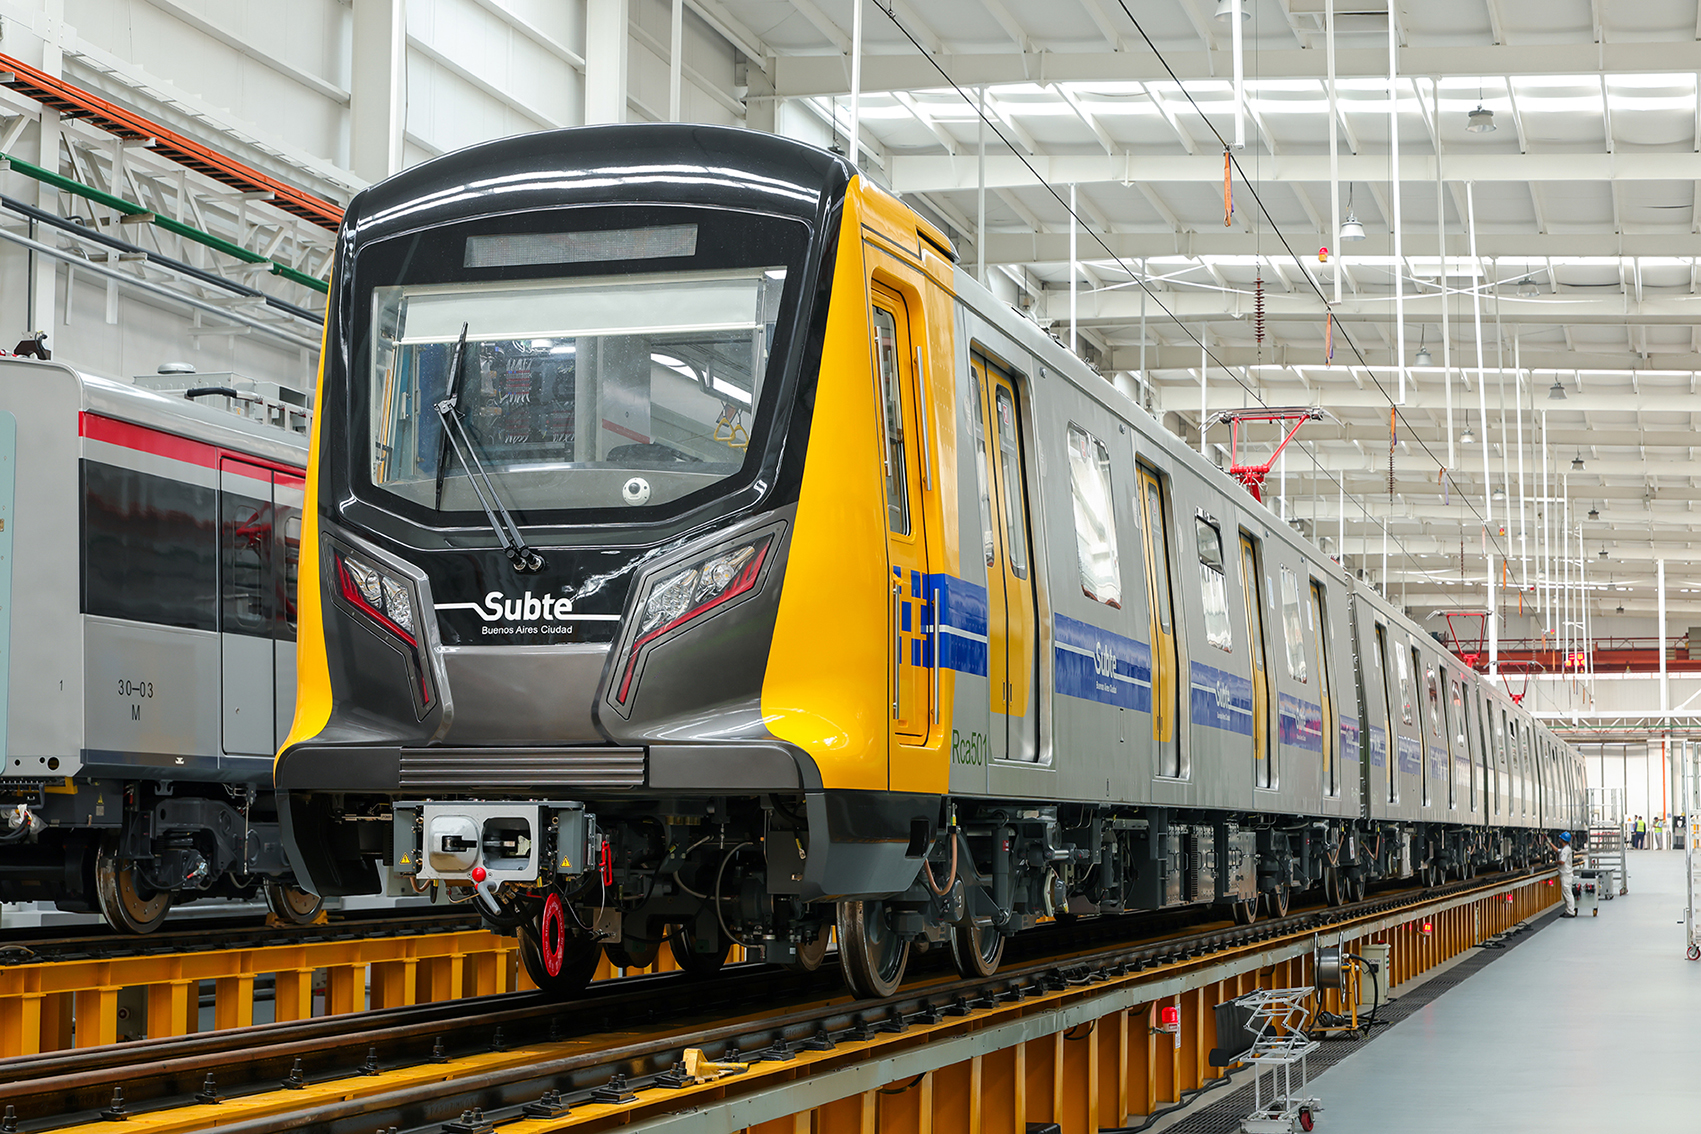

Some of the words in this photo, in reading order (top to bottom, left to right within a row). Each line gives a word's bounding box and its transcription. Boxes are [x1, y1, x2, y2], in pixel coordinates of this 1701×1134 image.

[483, 591, 573, 621] Subte
[481, 625, 514, 635] Buenos
[515, 625, 538, 634] Aires
[540, 625, 573, 634] Ciudad
[1095, 641, 1117, 679] Subte
[59, 680, 64, 691] 1
[131, 704, 141, 721] M
[952, 728, 988, 767] Rca501
